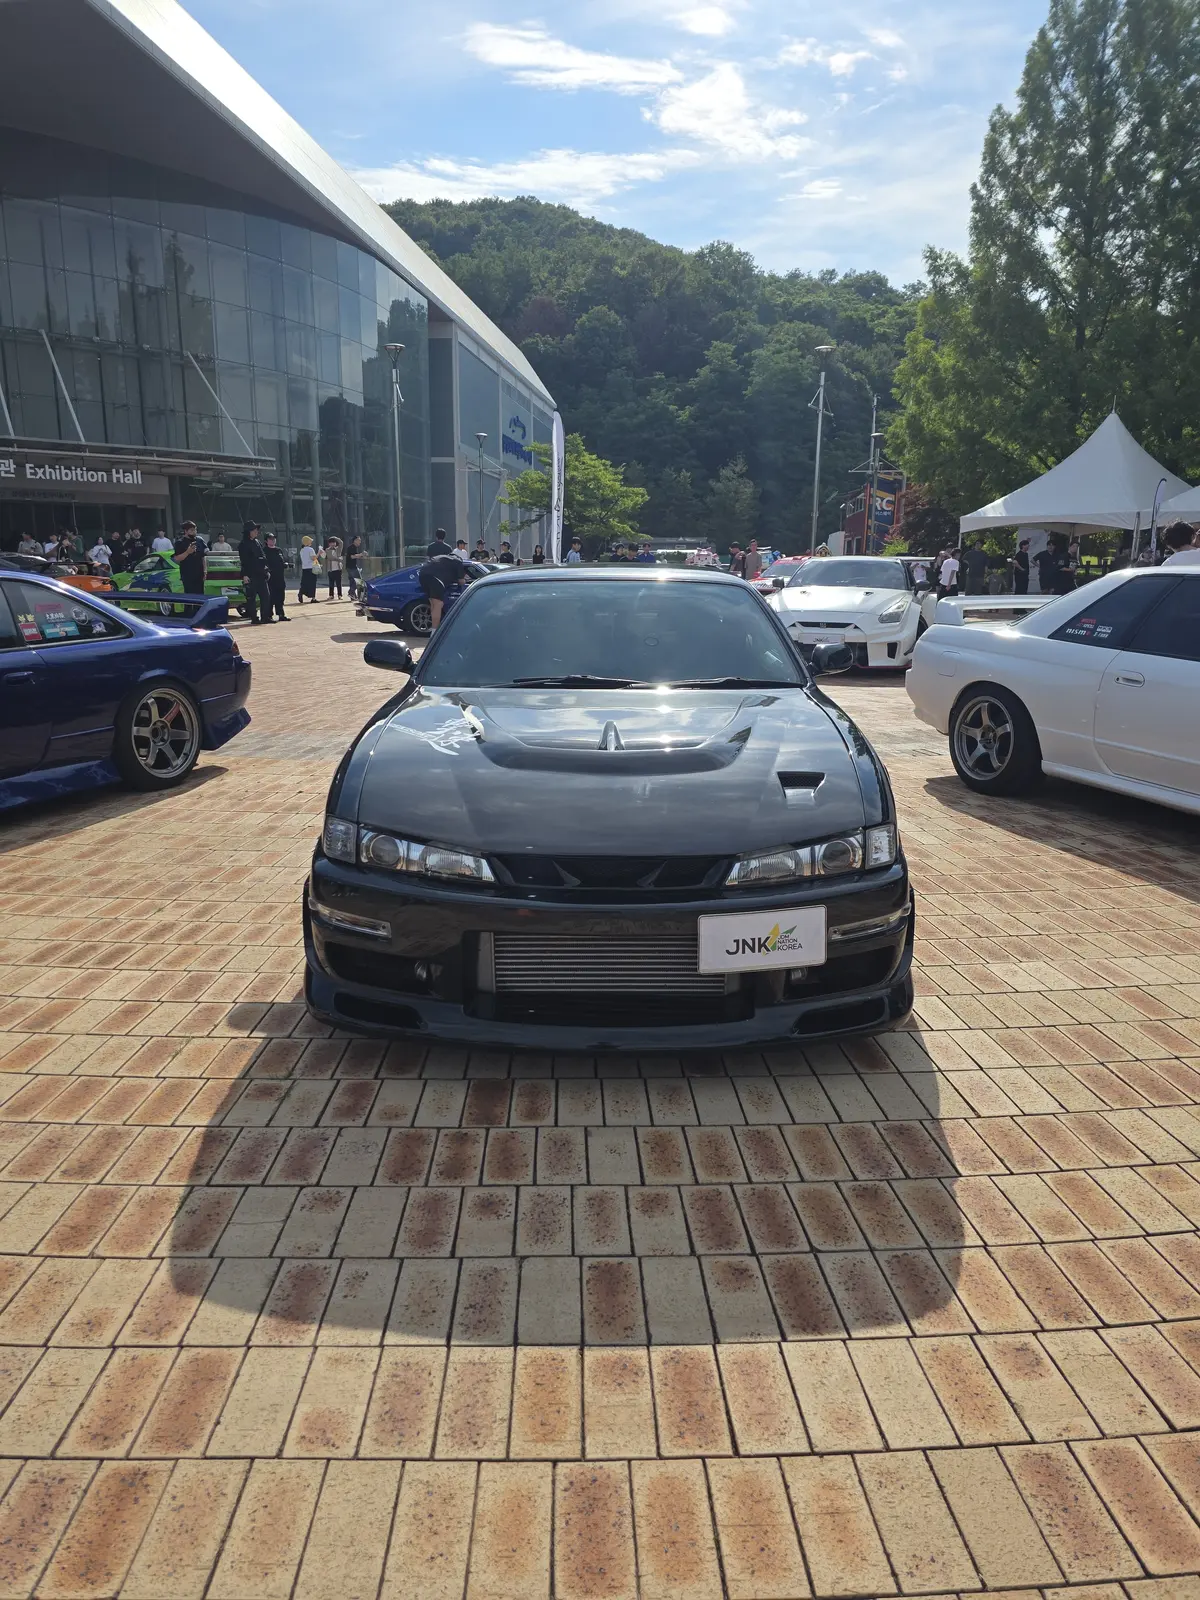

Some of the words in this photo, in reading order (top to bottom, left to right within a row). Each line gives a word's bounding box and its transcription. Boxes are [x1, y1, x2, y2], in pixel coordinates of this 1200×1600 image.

[0, 459, 16, 478] 관
[25, 464, 107, 483] Exhibition
[112, 469, 142, 485] Hall
[726, 936, 771, 955] JNK
[777, 943, 803, 951] KOREA
